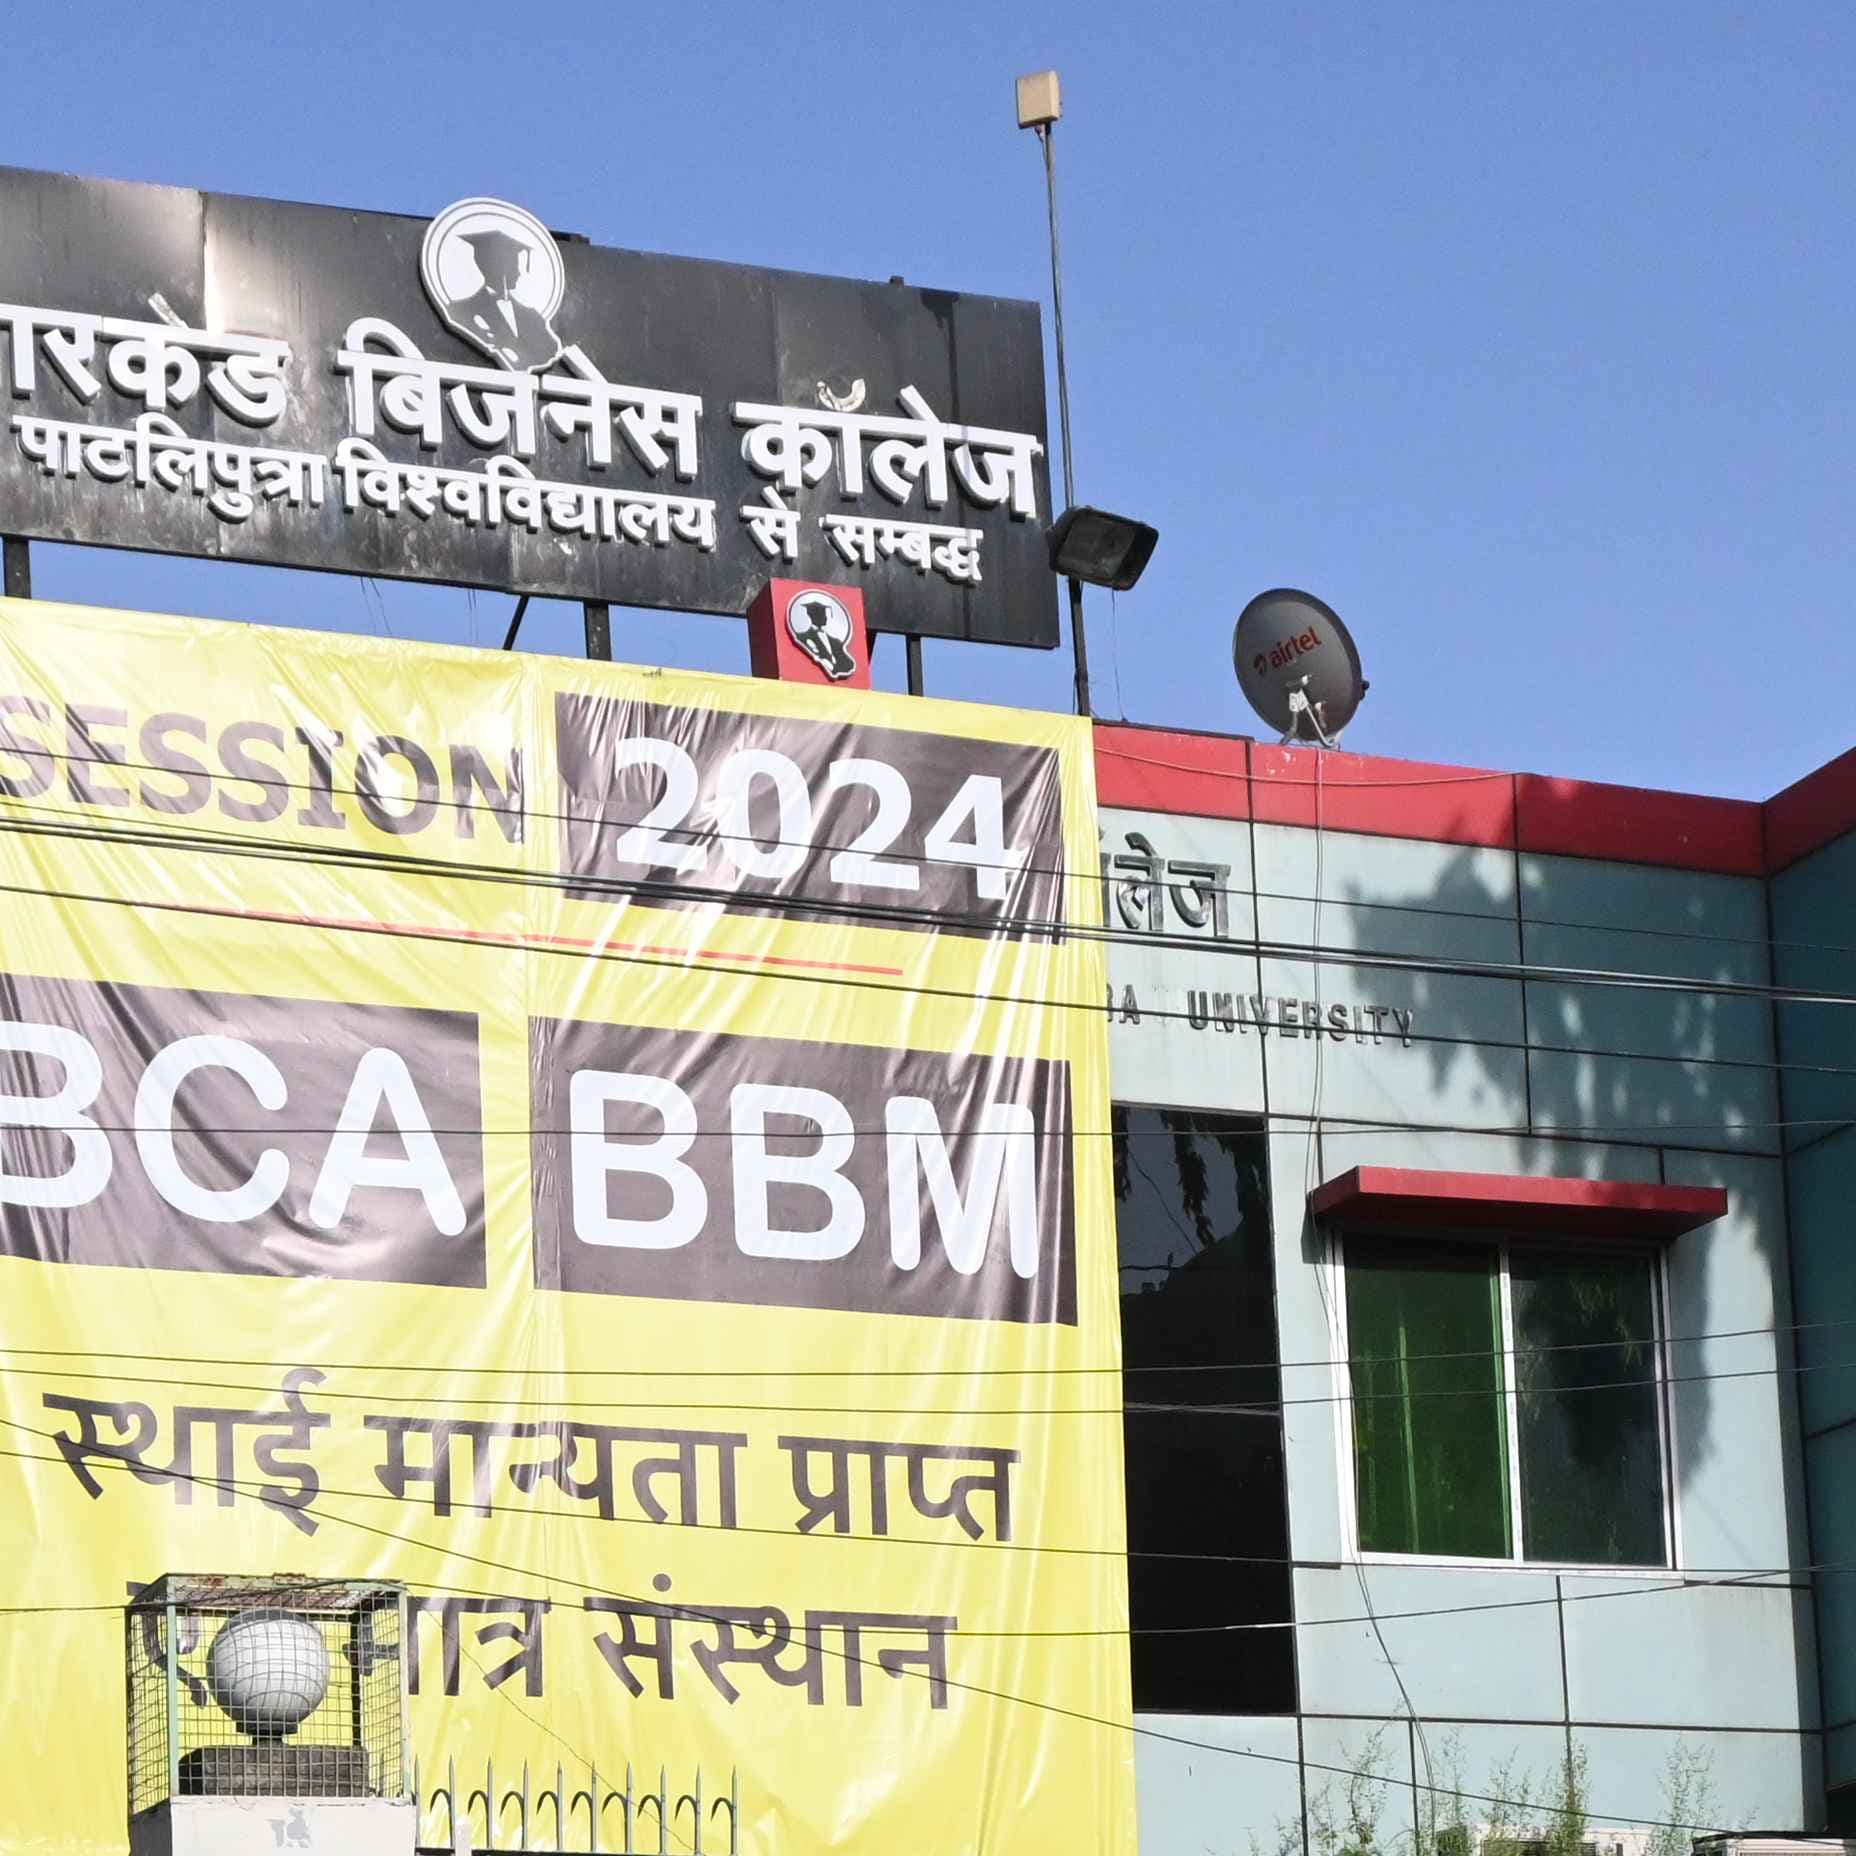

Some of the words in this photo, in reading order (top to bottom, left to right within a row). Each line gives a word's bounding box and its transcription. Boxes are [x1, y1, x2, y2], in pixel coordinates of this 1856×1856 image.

[12, 413, 328, 523] पाटलिपुत्रा
[334, 437, 717, 552] विश्वविद्यालय
[739, 486, 801, 559] से
[819, 514, 985, 586] सम्बद्ध
[334, 316, 704, 480] बिजनेस
[731, 378, 1044, 519] कॉलेज
[1269, 625, 1322, 669] airtel
[612, 737, 1020, 901] 2024
[1187, 989, 1417, 1049] UNIVERSITY
[568, 1068, 1039, 1280] BBM
[43, 1366, 332, 1534] स्थाई
[363, 1413, 748, 1530] मान्यता
[778, 1435, 1022, 1543] प्राप्त
[584, 1573, 958, 1711] संस्थान
